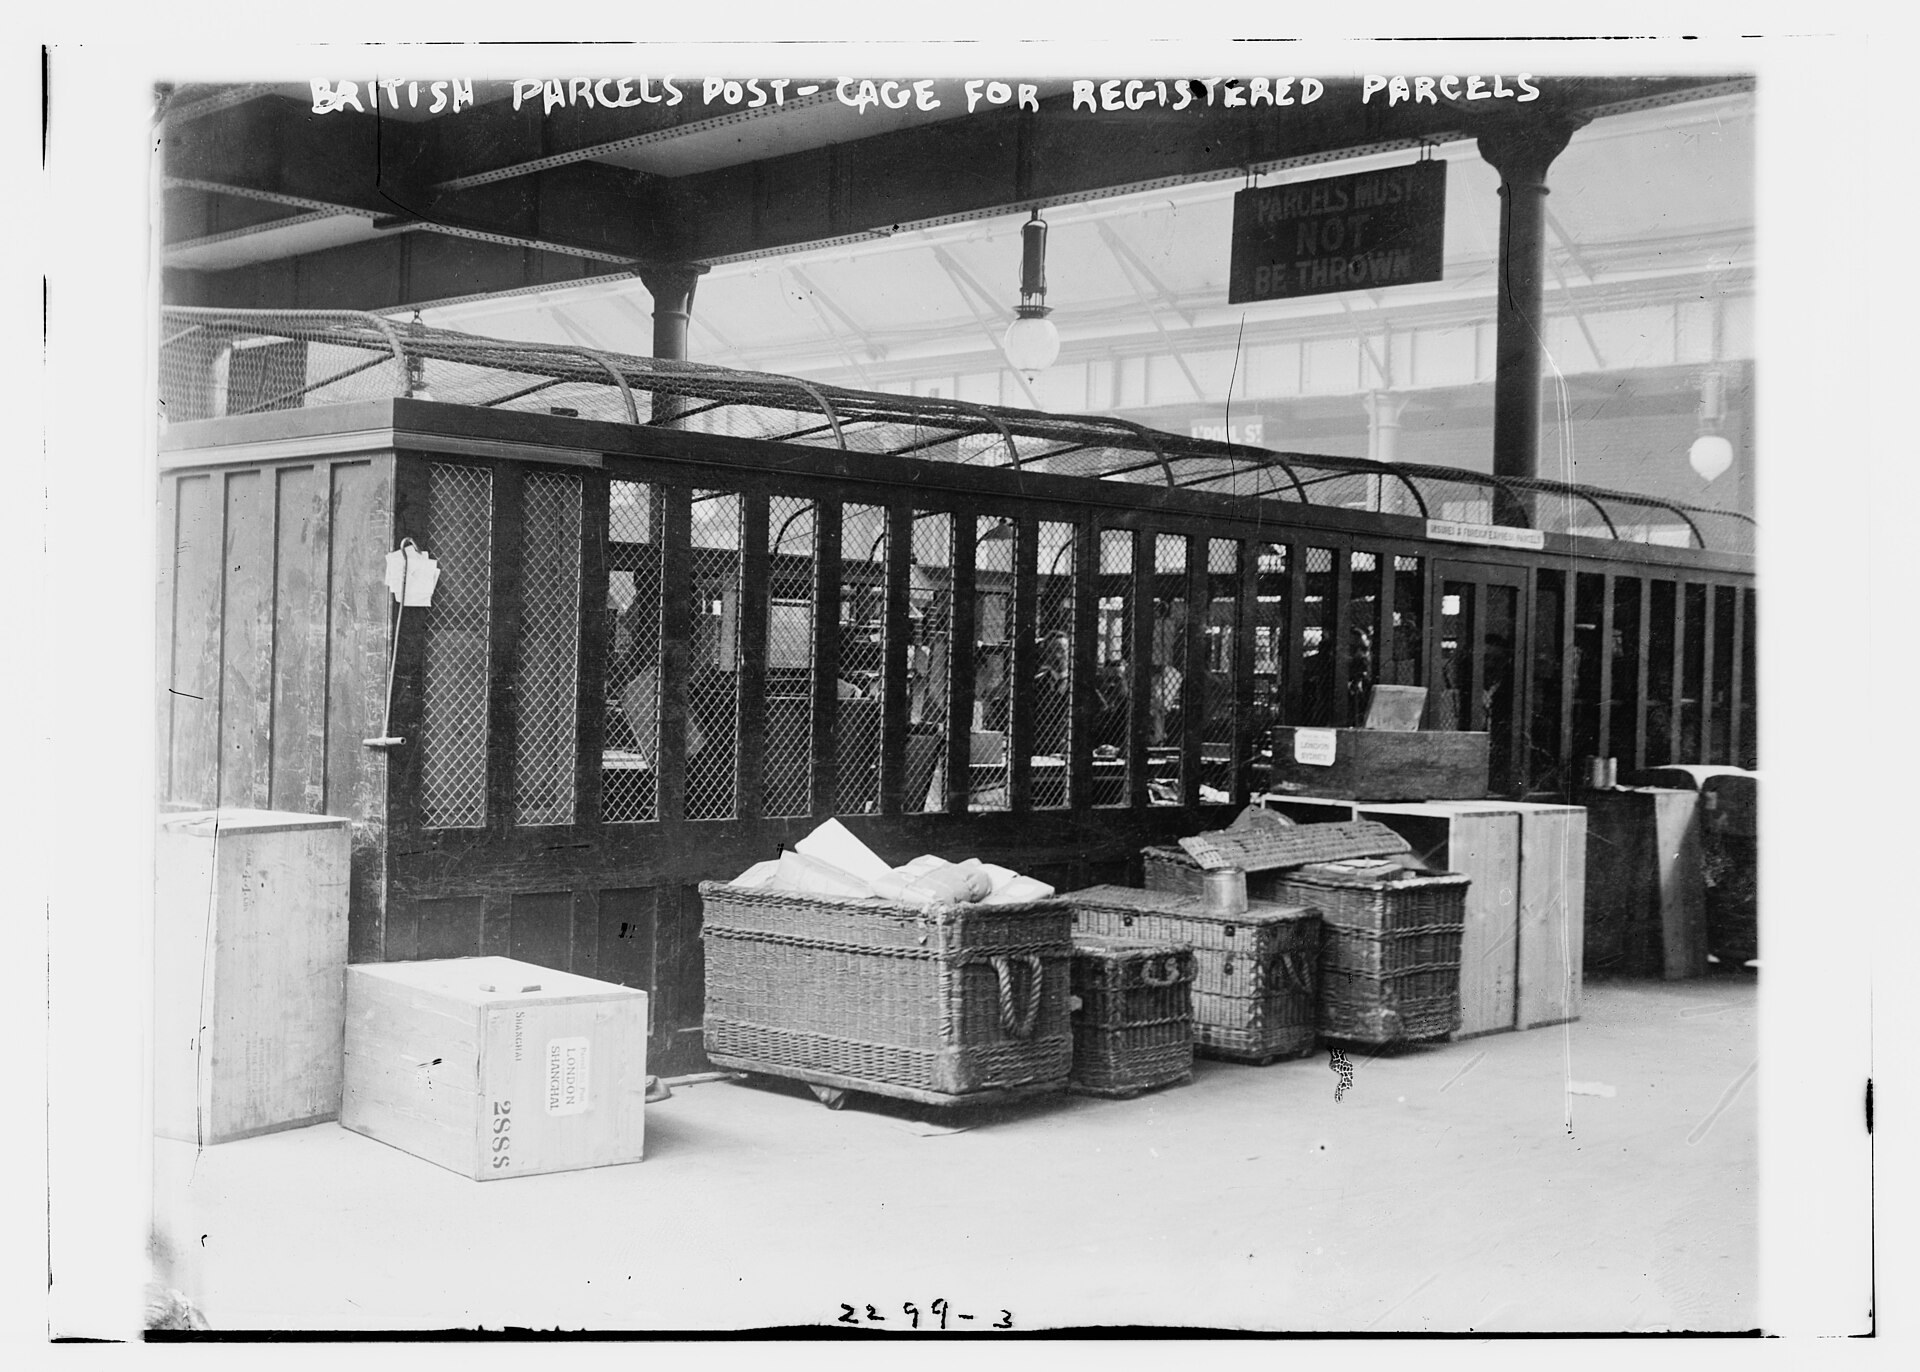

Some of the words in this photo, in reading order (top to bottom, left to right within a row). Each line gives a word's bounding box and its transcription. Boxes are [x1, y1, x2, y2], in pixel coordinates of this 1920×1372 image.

[1257, 186, 1349, 223] PARCELS
[1353, 175, 1412, 209] MUST
[1296, 214, 1370, 255] NOT
[1255, 263, 1287, 295] BE
[1294, 250, 1412, 290] THROWN
[514, 1011, 525, 1061] SHANGHAI
[566, 1047, 577, 1104] LONDON
